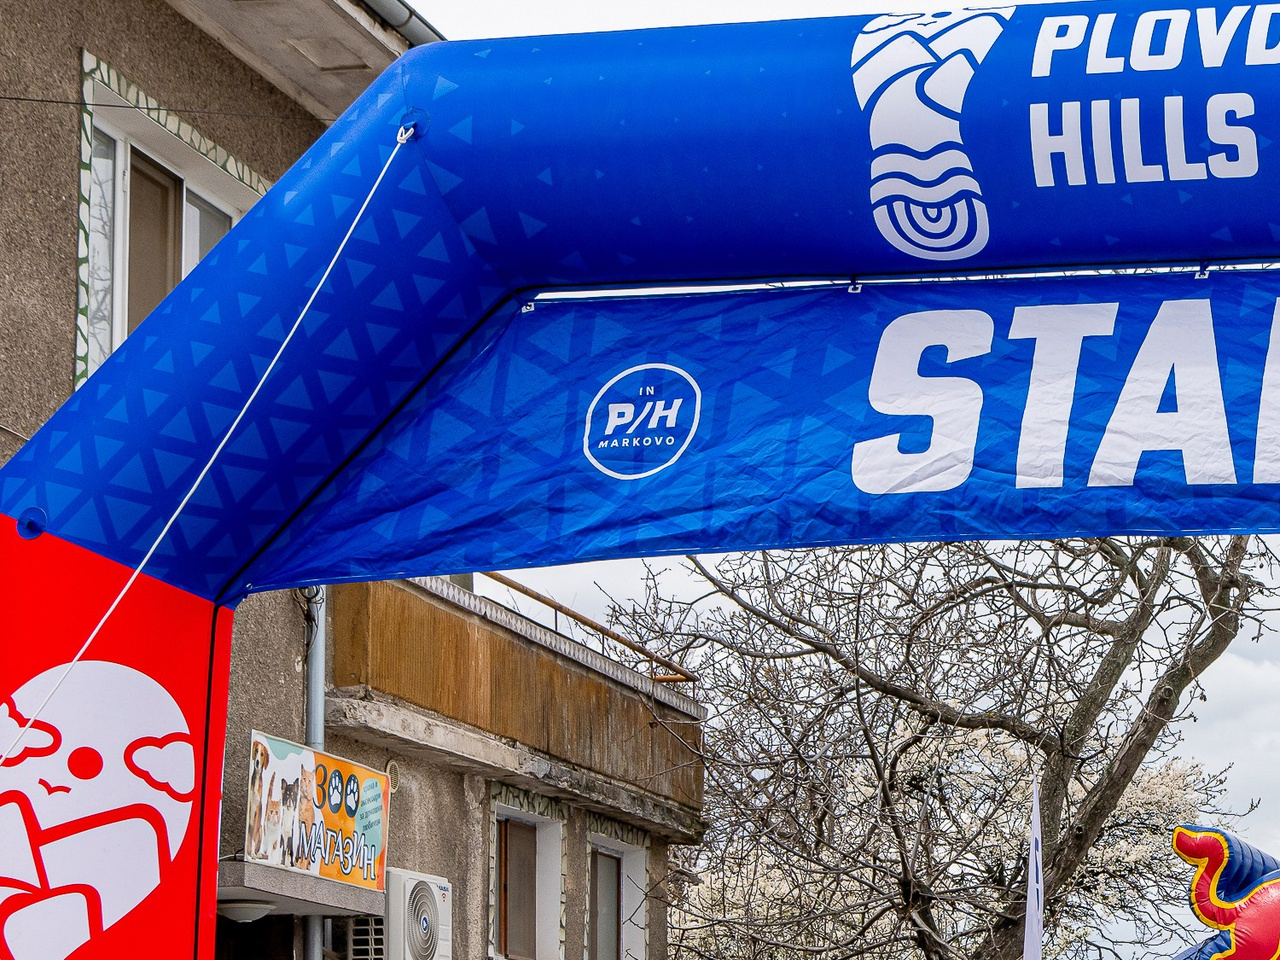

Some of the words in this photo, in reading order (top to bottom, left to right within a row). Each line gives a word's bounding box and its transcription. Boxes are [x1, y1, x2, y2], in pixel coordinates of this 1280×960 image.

[1029, 92, 1259, 187] HILLS
[639, 386, 655, 396] IN
[604, 398, 683, 435] P/H
[598, 436, 675, 448] MARKOVO
[299, 820, 377, 880] МАГАЗИН
